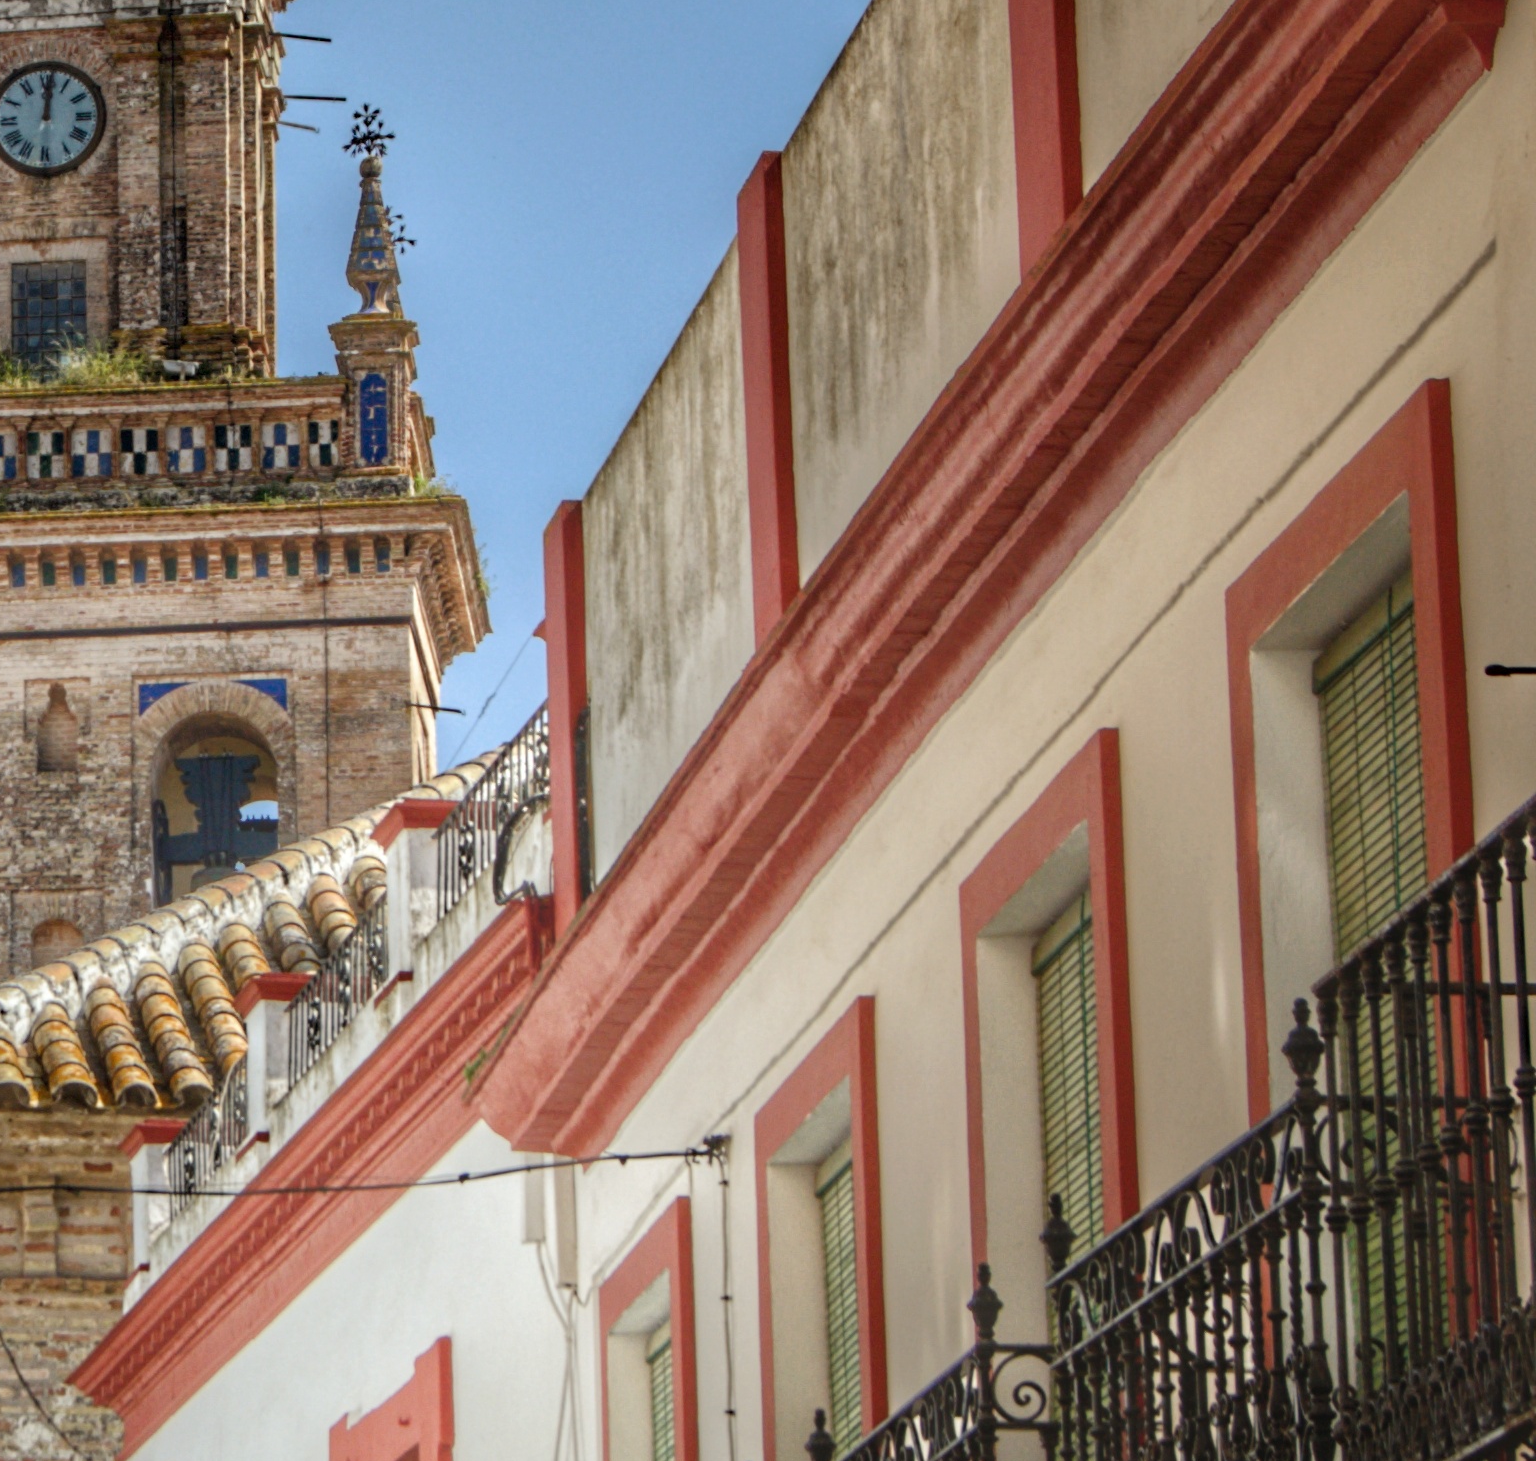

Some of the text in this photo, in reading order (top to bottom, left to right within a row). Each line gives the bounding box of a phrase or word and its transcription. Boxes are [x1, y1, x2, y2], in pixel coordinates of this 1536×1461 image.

[60, 78, 70, 94] I
[70, 92, 87, 105] II
[75, 112, 92, 121] III
